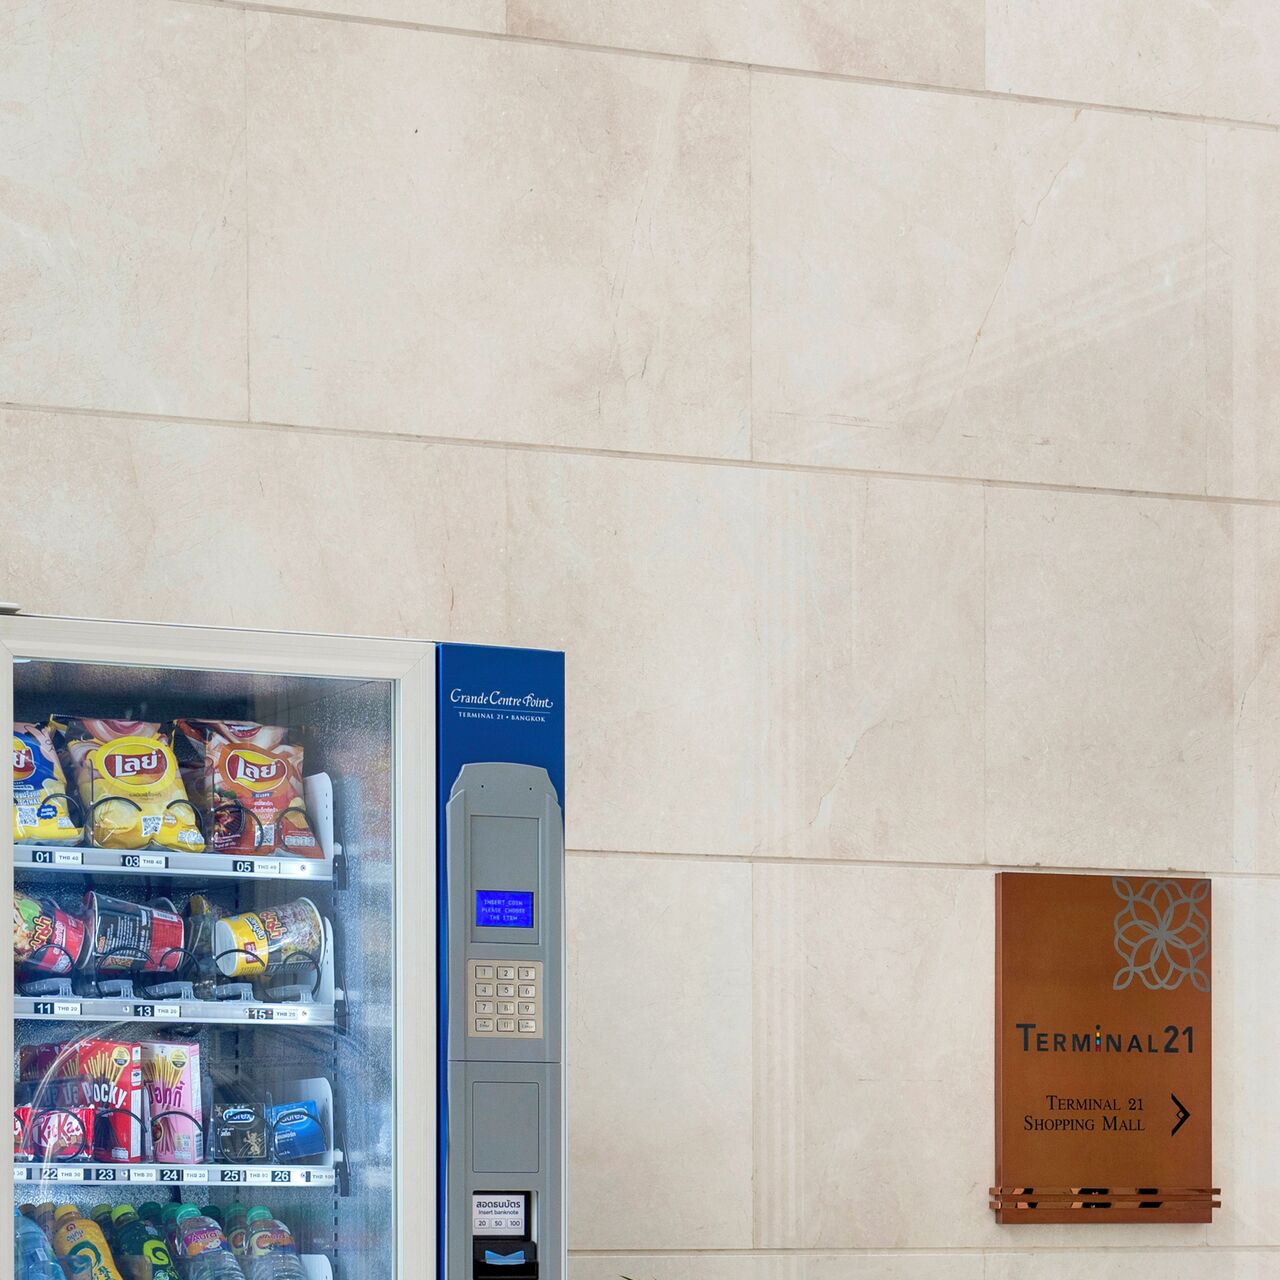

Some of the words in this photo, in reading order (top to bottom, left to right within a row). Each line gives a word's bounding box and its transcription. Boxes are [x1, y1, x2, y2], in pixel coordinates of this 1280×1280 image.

[450, 688, 488, 704] Grande
[489, 690, 521, 706] Centre
[522, 693, 554, 708] Point
[458, 711, 494, 719] TERMINAL
[511, 714, 545, 722] BANGKOK
[115, 751, 159, 777] เลย์
[237, 757, 277, 782] เลย์
[36, 853, 50, 862] 01
[124, 856, 139, 867] 03
[236, 862, 252, 872] 05
[37, 1003, 51, 1014] 11
[137, 1006, 151, 1016] 13
[252, 1009, 266, 1019] 15
[1046, 1094, 1121, 1111] TERMINAL
[1128, 1098, 1144, 1111] 21
[1024, 1115, 1095, 1132] SHOPPING
[1102, 1115, 1146, 1132] MALL
[43, 1168, 58, 1180] 22
[98, 1169, 114, 1180] 23
[163, 1170, 178, 1181] 24
[224, 1170, 239, 1181] 25
[274, 1171, 289, 1182] 26
[476, 1199, 521, 1209] สอดธนบัตร
